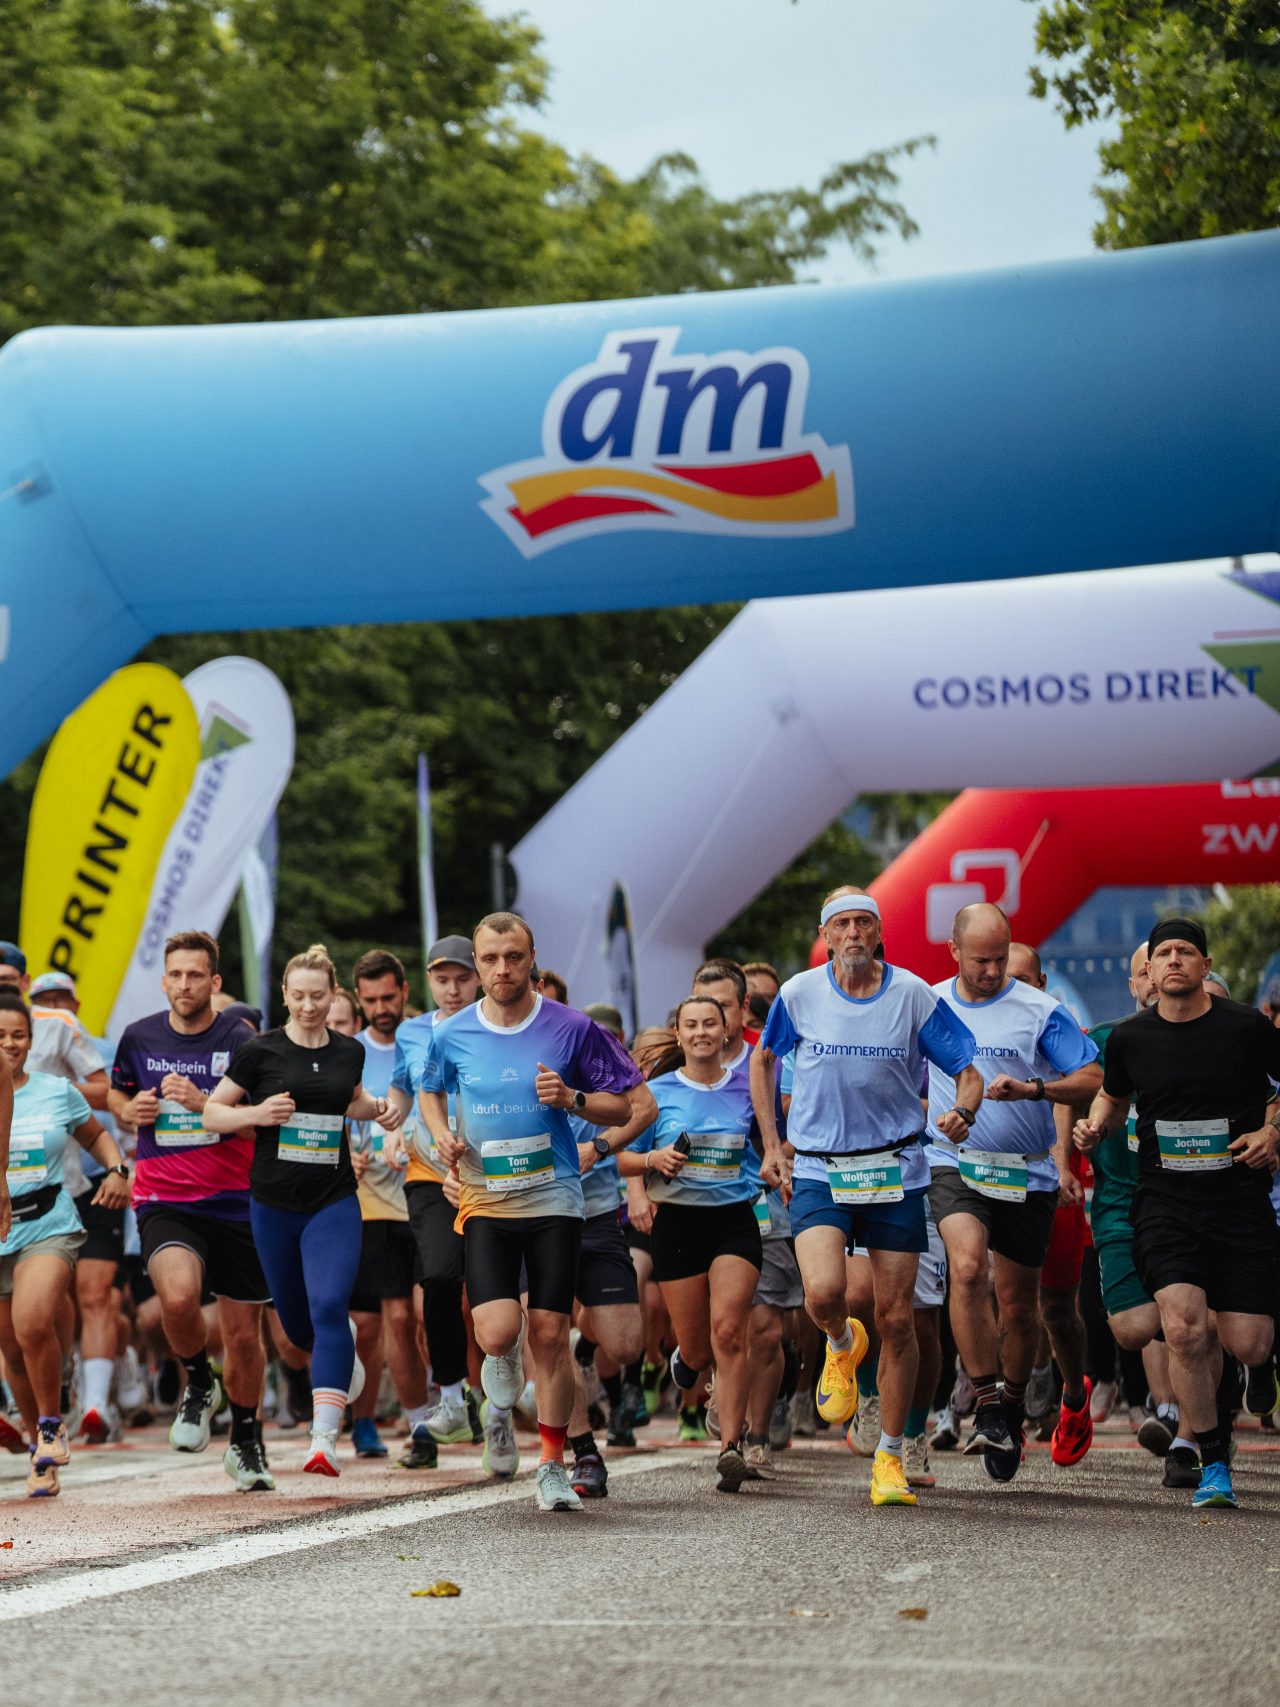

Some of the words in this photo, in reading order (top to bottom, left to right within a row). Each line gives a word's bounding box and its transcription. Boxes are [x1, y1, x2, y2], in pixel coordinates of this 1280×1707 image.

[558, 338, 793, 463] dm
[913, 673, 1092, 710] COSMOS
[1106, 665, 1263, 701] DIREKT
[47, 702, 174, 983] PRINTER
[1201, 823, 1280, 854] ZW
[146, 1057, 207, 1075] Dabeisein
[472, 1103, 500, 1115] Läuft
[504, 1103, 523, 1114] bei
[297, 1129, 328, 1142] Nadine
[1174, 1138, 1211, 1148] Jochen
[689, 1148, 732, 1160] Anastasia
[507, 1156, 529, 1167] Tom
[840, 1171, 887, 1182] Wolfgang
[974, 1165, 1010, 1178] Markus
